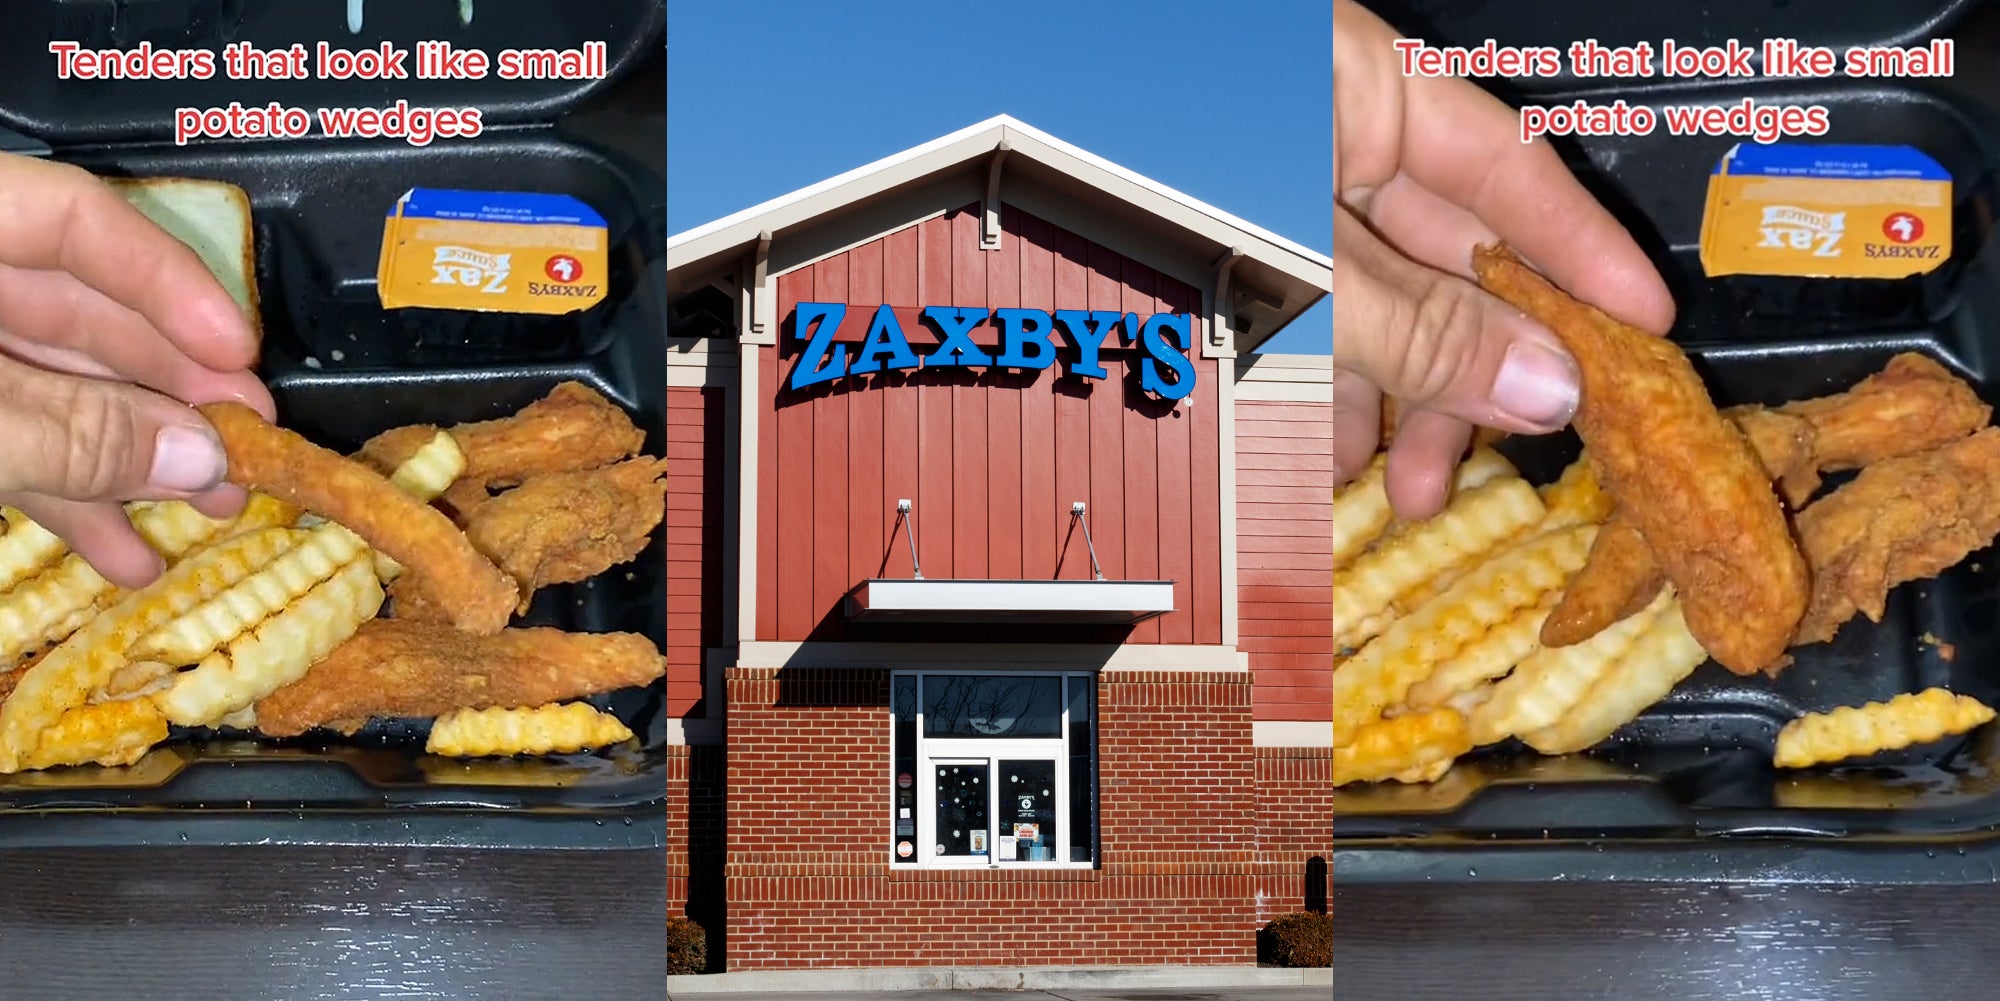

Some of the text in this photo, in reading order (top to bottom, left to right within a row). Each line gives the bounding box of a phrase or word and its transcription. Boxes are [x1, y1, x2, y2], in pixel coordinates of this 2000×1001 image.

[1757, 228, 1844, 257] Zax
[1864, 243, 1941, 260] ZAXBY'S
[445, 249, 499, 269] Sauce
[430, 265, 509, 293] Zax
[528, 282, 598, 298] ZAXBY'S
[791, 302, 1197, 400] ZAXBY'S
